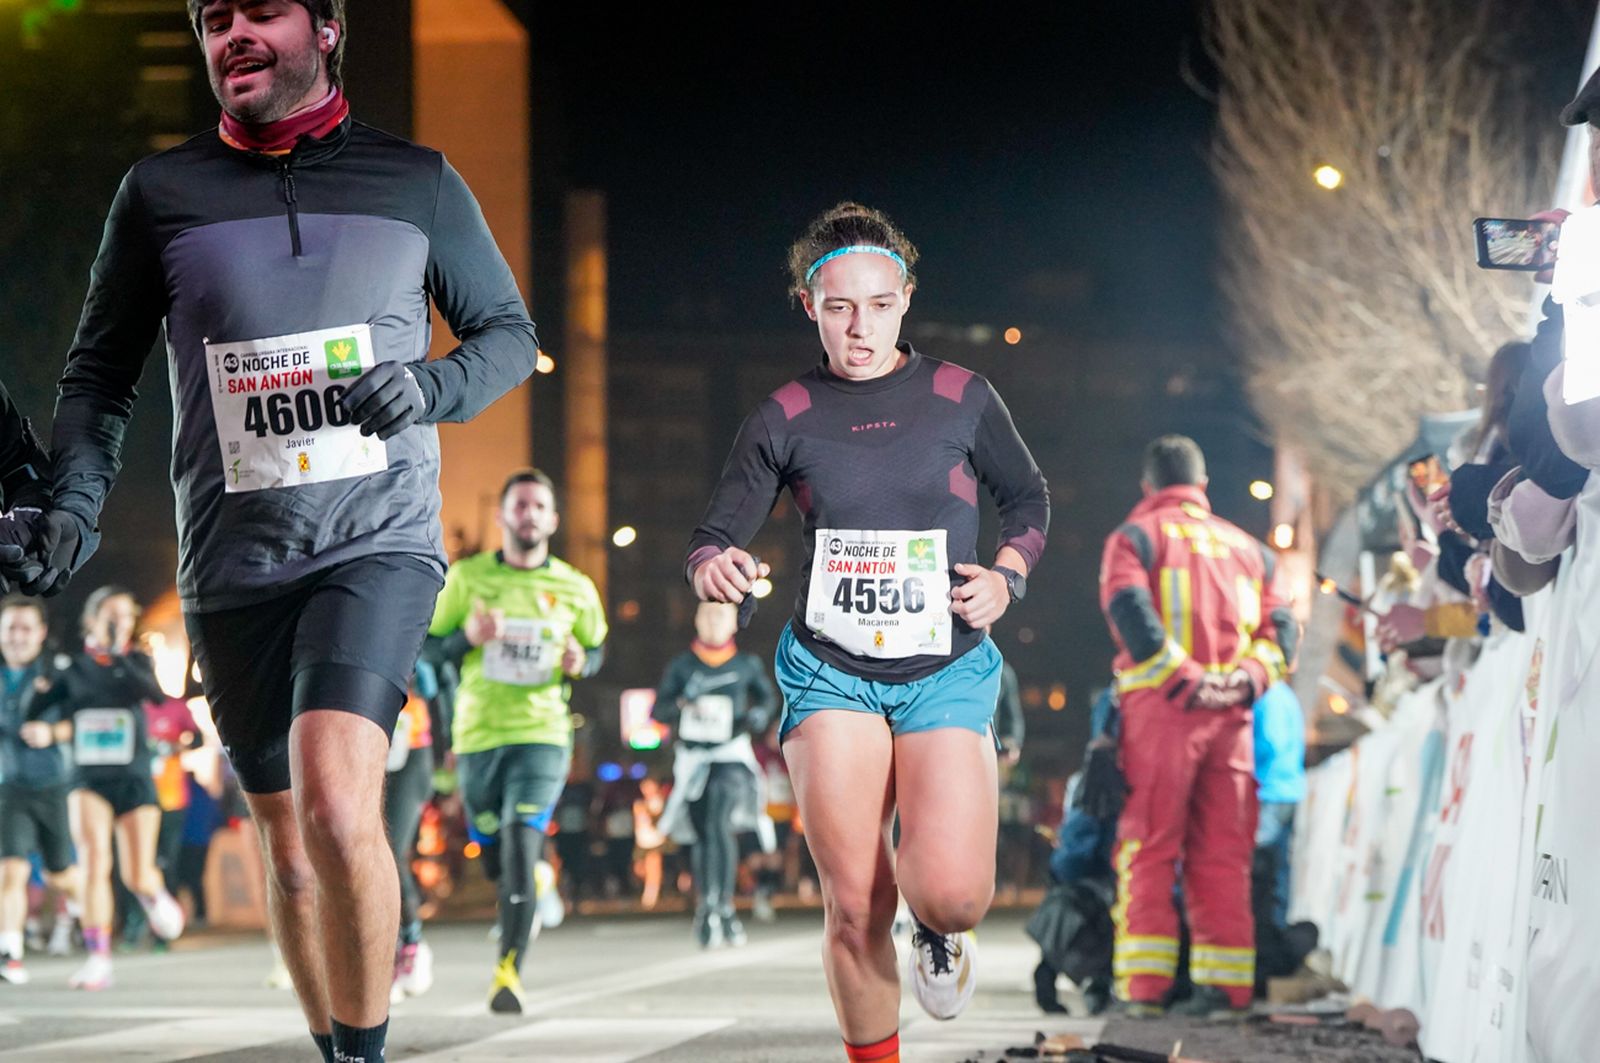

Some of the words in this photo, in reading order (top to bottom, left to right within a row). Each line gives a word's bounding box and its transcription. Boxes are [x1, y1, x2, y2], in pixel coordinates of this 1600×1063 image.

[225, 355, 238, 369] 43
[242, 354, 288, 373] NOCHE
[293, 351, 310, 366] DE
[228, 376, 256, 394] SAN
[260, 366, 313, 391] ANTÓN
[245, 384, 351, 438] 4606
[851, 421, 896, 432] KIPSTA
[285, 437, 315, 449] Javier
[843, 545, 880, 557] NOCHE
[882, 545, 897, 558] DE
[827, 559, 853, 573] SAN
[854, 558, 896, 574] ANTÓN
[832, 577, 925, 615] 4556
[858, 618, 899, 626] Macarena
